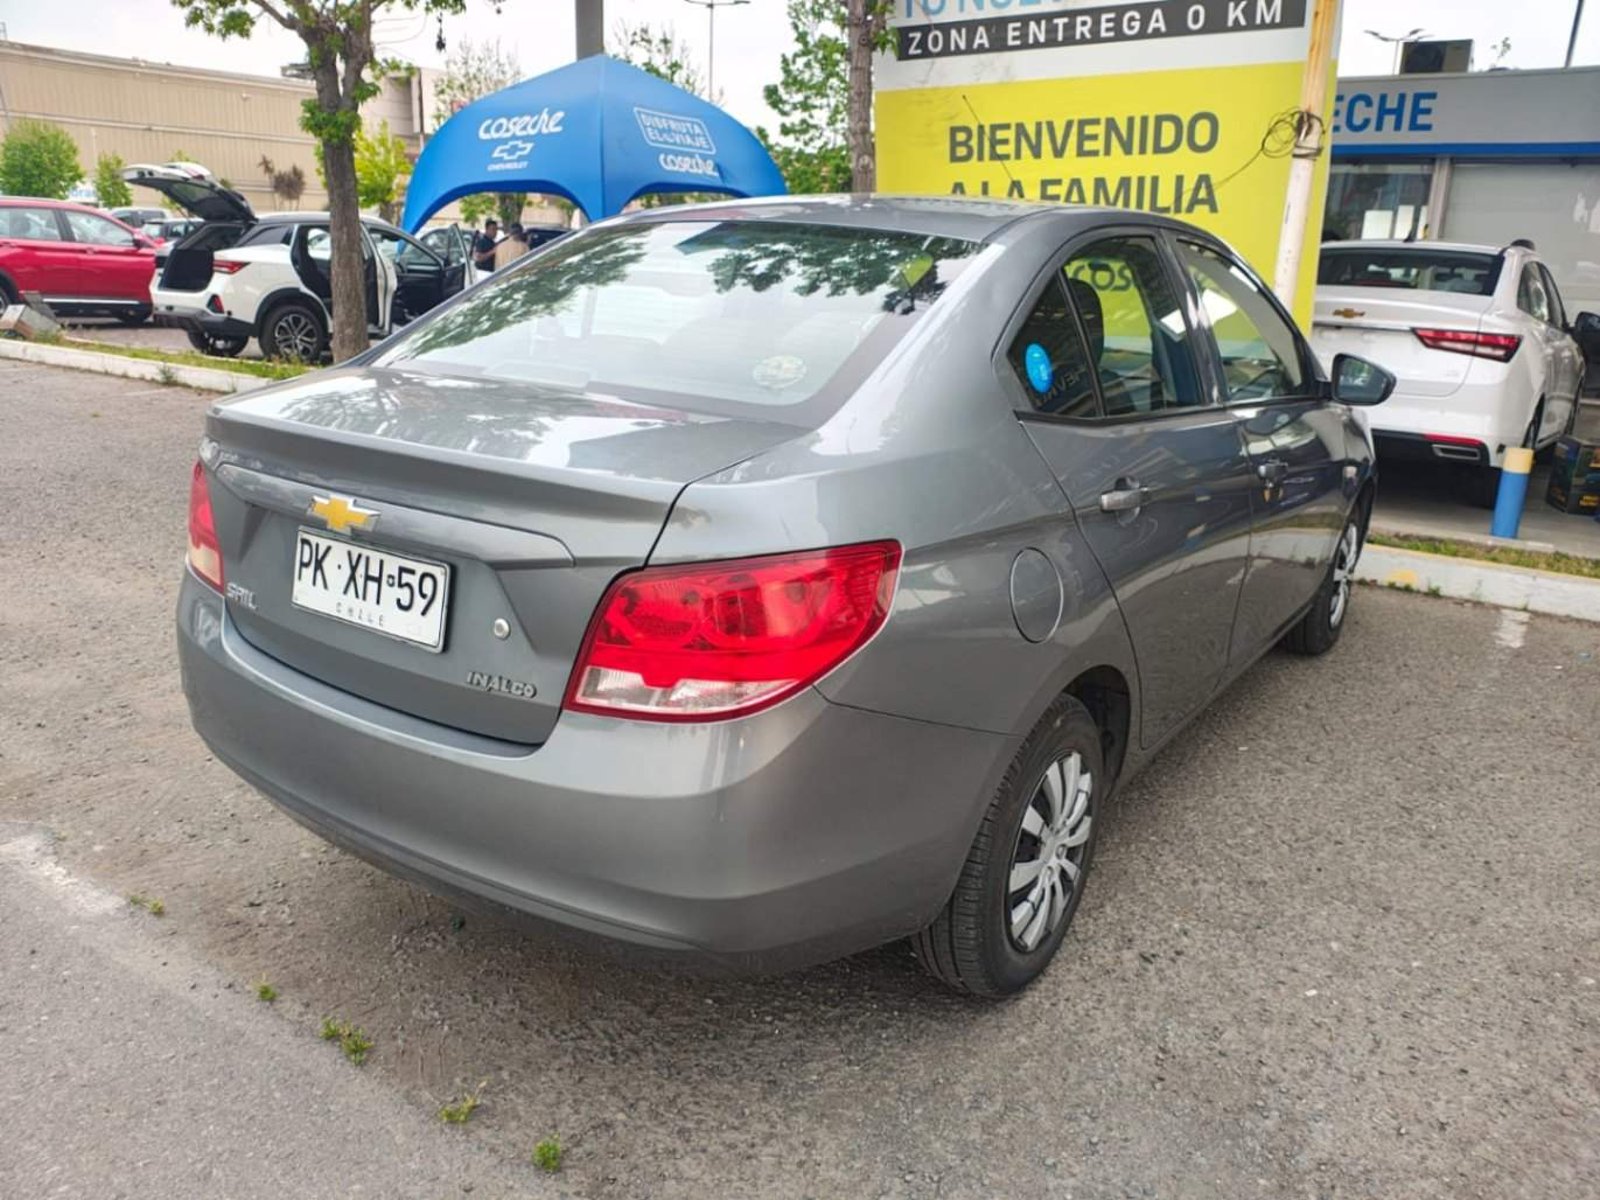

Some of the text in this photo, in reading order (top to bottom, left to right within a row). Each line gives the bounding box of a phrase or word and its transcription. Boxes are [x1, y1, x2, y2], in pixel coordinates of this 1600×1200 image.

[908, 26, 990, 55] ZONA
[1006, 8, 1167, 46] ENTREGA
[1227, 0, 1283, 27] KM
[949, 111, 1219, 164] BIENVENIDO
[1040, 174, 1219, 214] FAMILIA
[466, 671, 537, 699] INALCO
